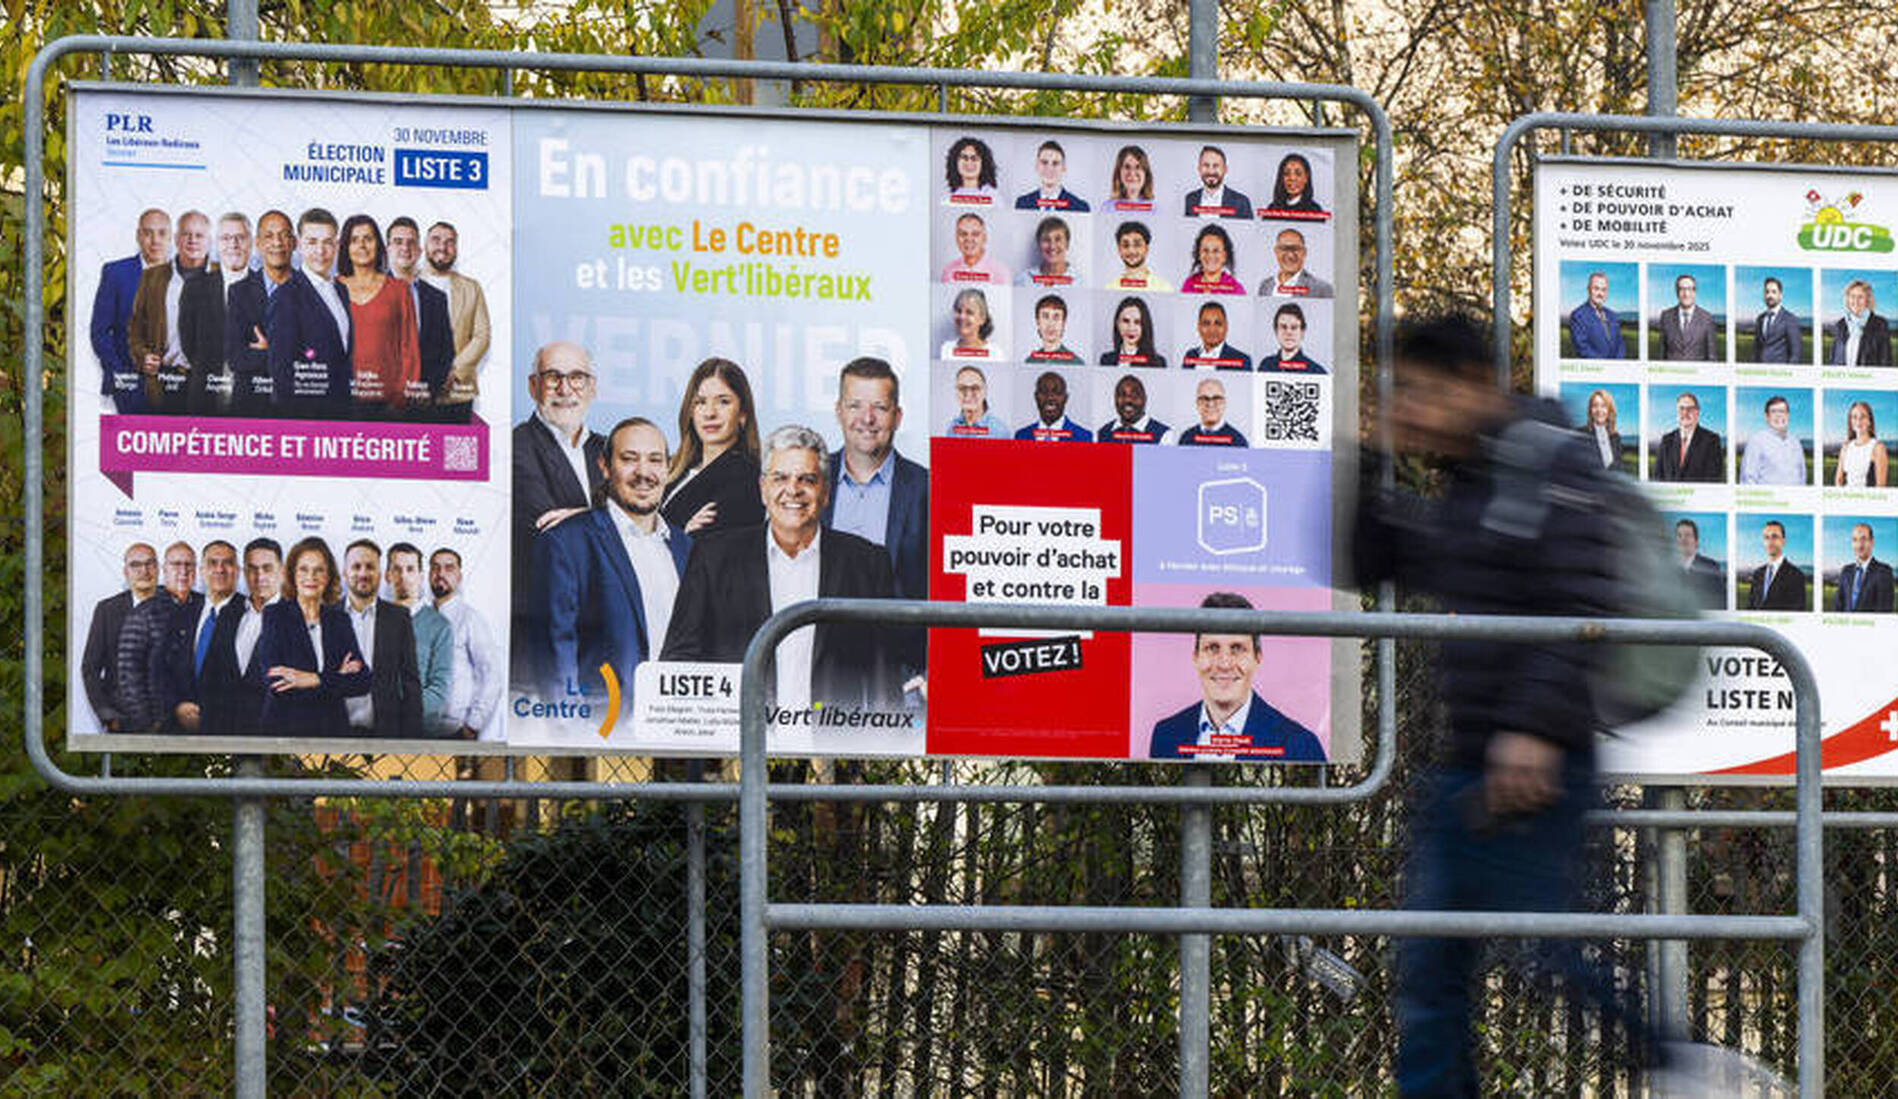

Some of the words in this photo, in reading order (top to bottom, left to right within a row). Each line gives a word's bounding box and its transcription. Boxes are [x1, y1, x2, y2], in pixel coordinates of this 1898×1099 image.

[106, 113, 152, 133] PLR
[393, 127, 411, 143] 30
[413, 128, 488, 146] NOVEMBRE
[308, 142, 385, 162] ÉLECTION
[283, 164, 386, 184] MUNICIPALE
[402, 157, 464, 181] LISTE
[468, 160, 482, 181] 3
[539, 136, 607, 200] En
[627, 144, 911, 216] confiance
[1573, 185, 1592, 197] DE
[1597, 184, 1667, 199] SÉCURITÉ
[1573, 202, 1592, 214] DE
[1597, 203, 1665, 216] POUVOIR
[1669, 205, 1735, 218] D'ACHAT
[1573, 219, 1592, 232] DE
[1597, 220, 1668, 234] MOBILITÉ
[608, 223, 683, 252] avec
[692, 219, 726, 254] Le
[736, 222, 841, 259] Centre
[1588, 240, 1609, 249] UDC
[1638, 241, 1685, 251] novembre
[1812, 225, 1873, 250] UDC
[575, 260, 608, 288] et
[617, 257, 663, 291] les
[672, 260, 872, 301] Vert'libéraux
[117, 427, 273, 458] COMPÉTENCE
[281, 436, 307, 458] ET
[313, 432, 431, 463] INTÉGRITÉ
[1209, 506, 1238, 525] PS
[979, 515, 1031, 536] Pour
[1037, 520, 1095, 538] votre
[950, 547, 1031, 570] pouvoir
[1036, 548, 1117, 570] d'achat
[972, 580, 995, 597] et
[1002, 583, 1076, 600] contre
[1081, 580, 1100, 600] la
[1707, 656, 1785, 677] VOTEZ
[566, 677, 591, 696] Le
[660, 674, 714, 697] LISTE
[719, 675, 732, 698] 4
[514, 697, 592, 718] Centre
[1707, 689, 1771, 710] LISTE
[1777, 690, 1793, 710] N
